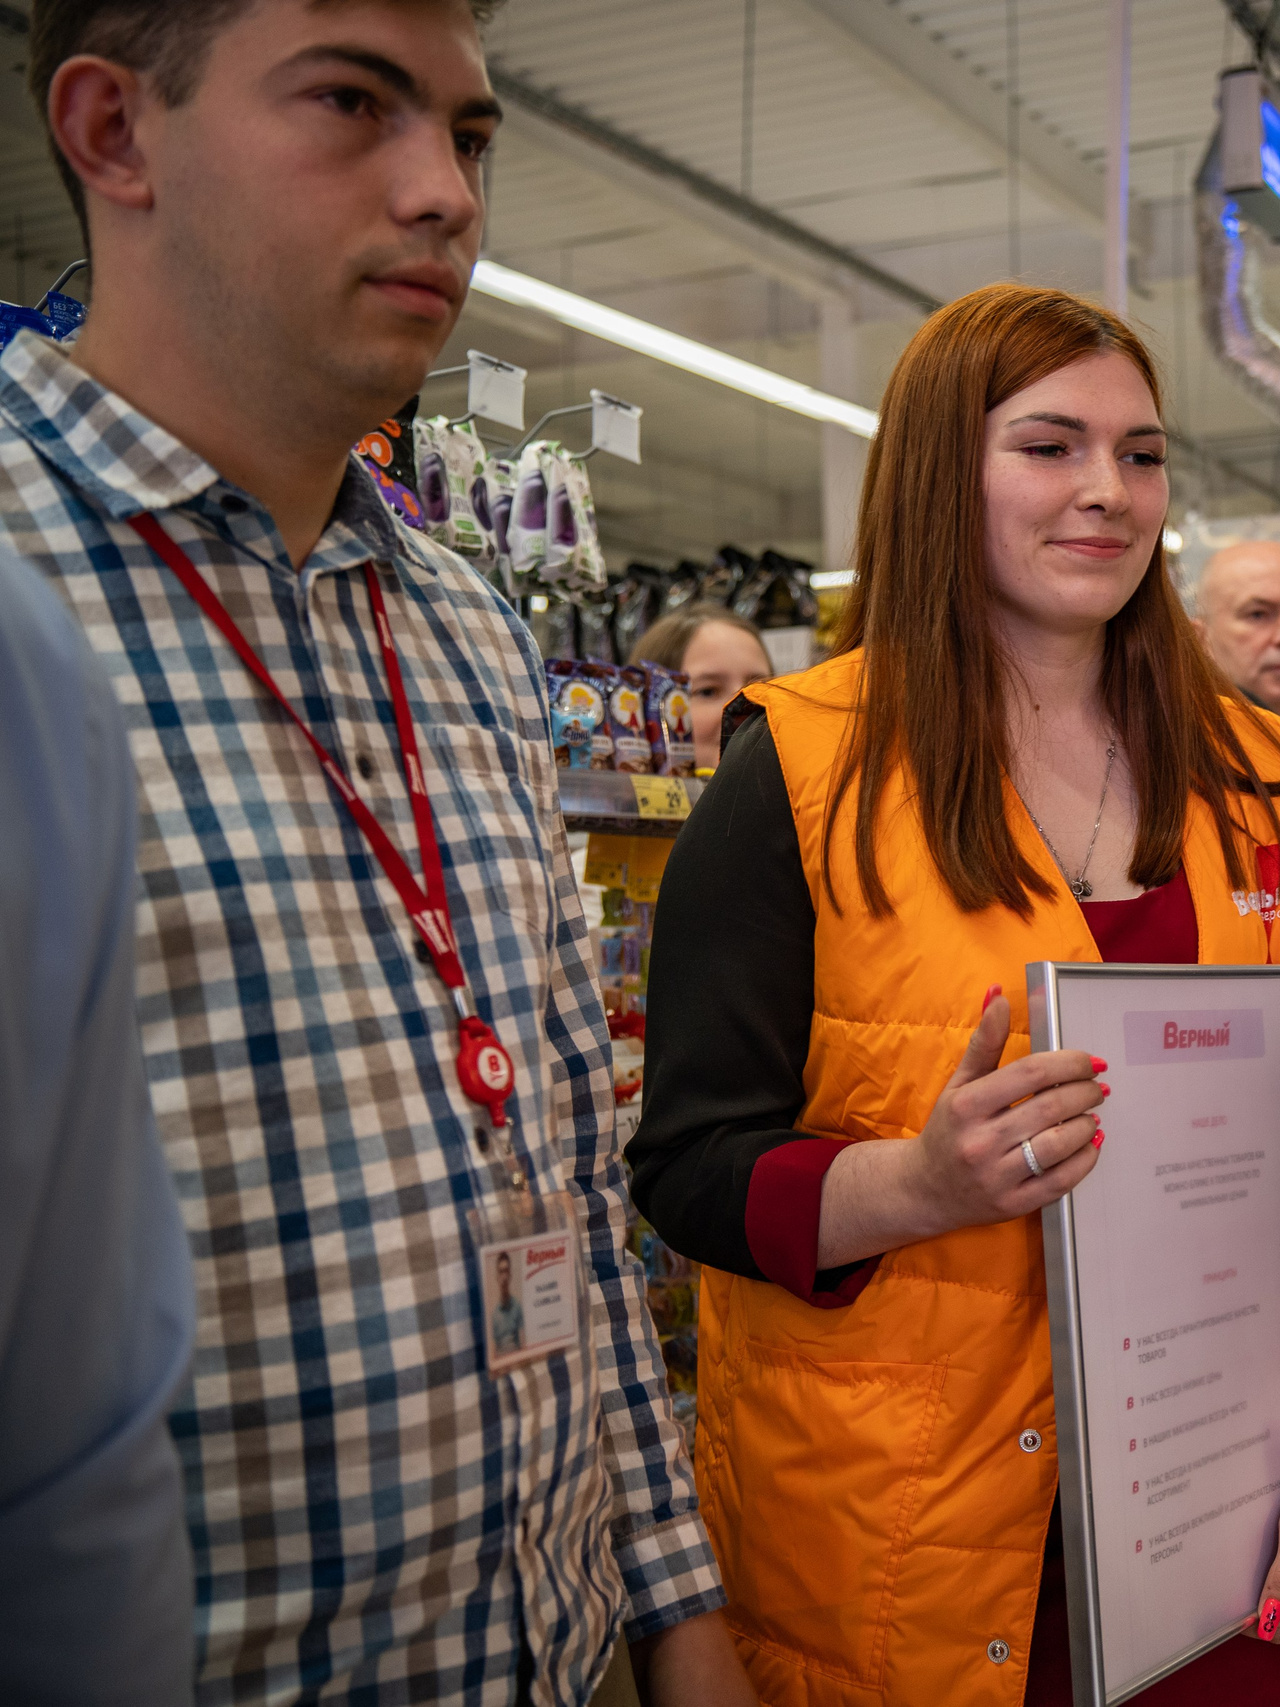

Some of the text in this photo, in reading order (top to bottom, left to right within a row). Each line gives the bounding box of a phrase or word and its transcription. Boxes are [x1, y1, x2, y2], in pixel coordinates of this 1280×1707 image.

[1137, 1347, 1167, 1364] ТОВАРОВ
[1154, 1531, 1168, 1546] НАС
[1168, 1522, 1190, 1540] ВСЕГДА
[1150, 1541, 1184, 1565] ПЕРСОНАЛ
